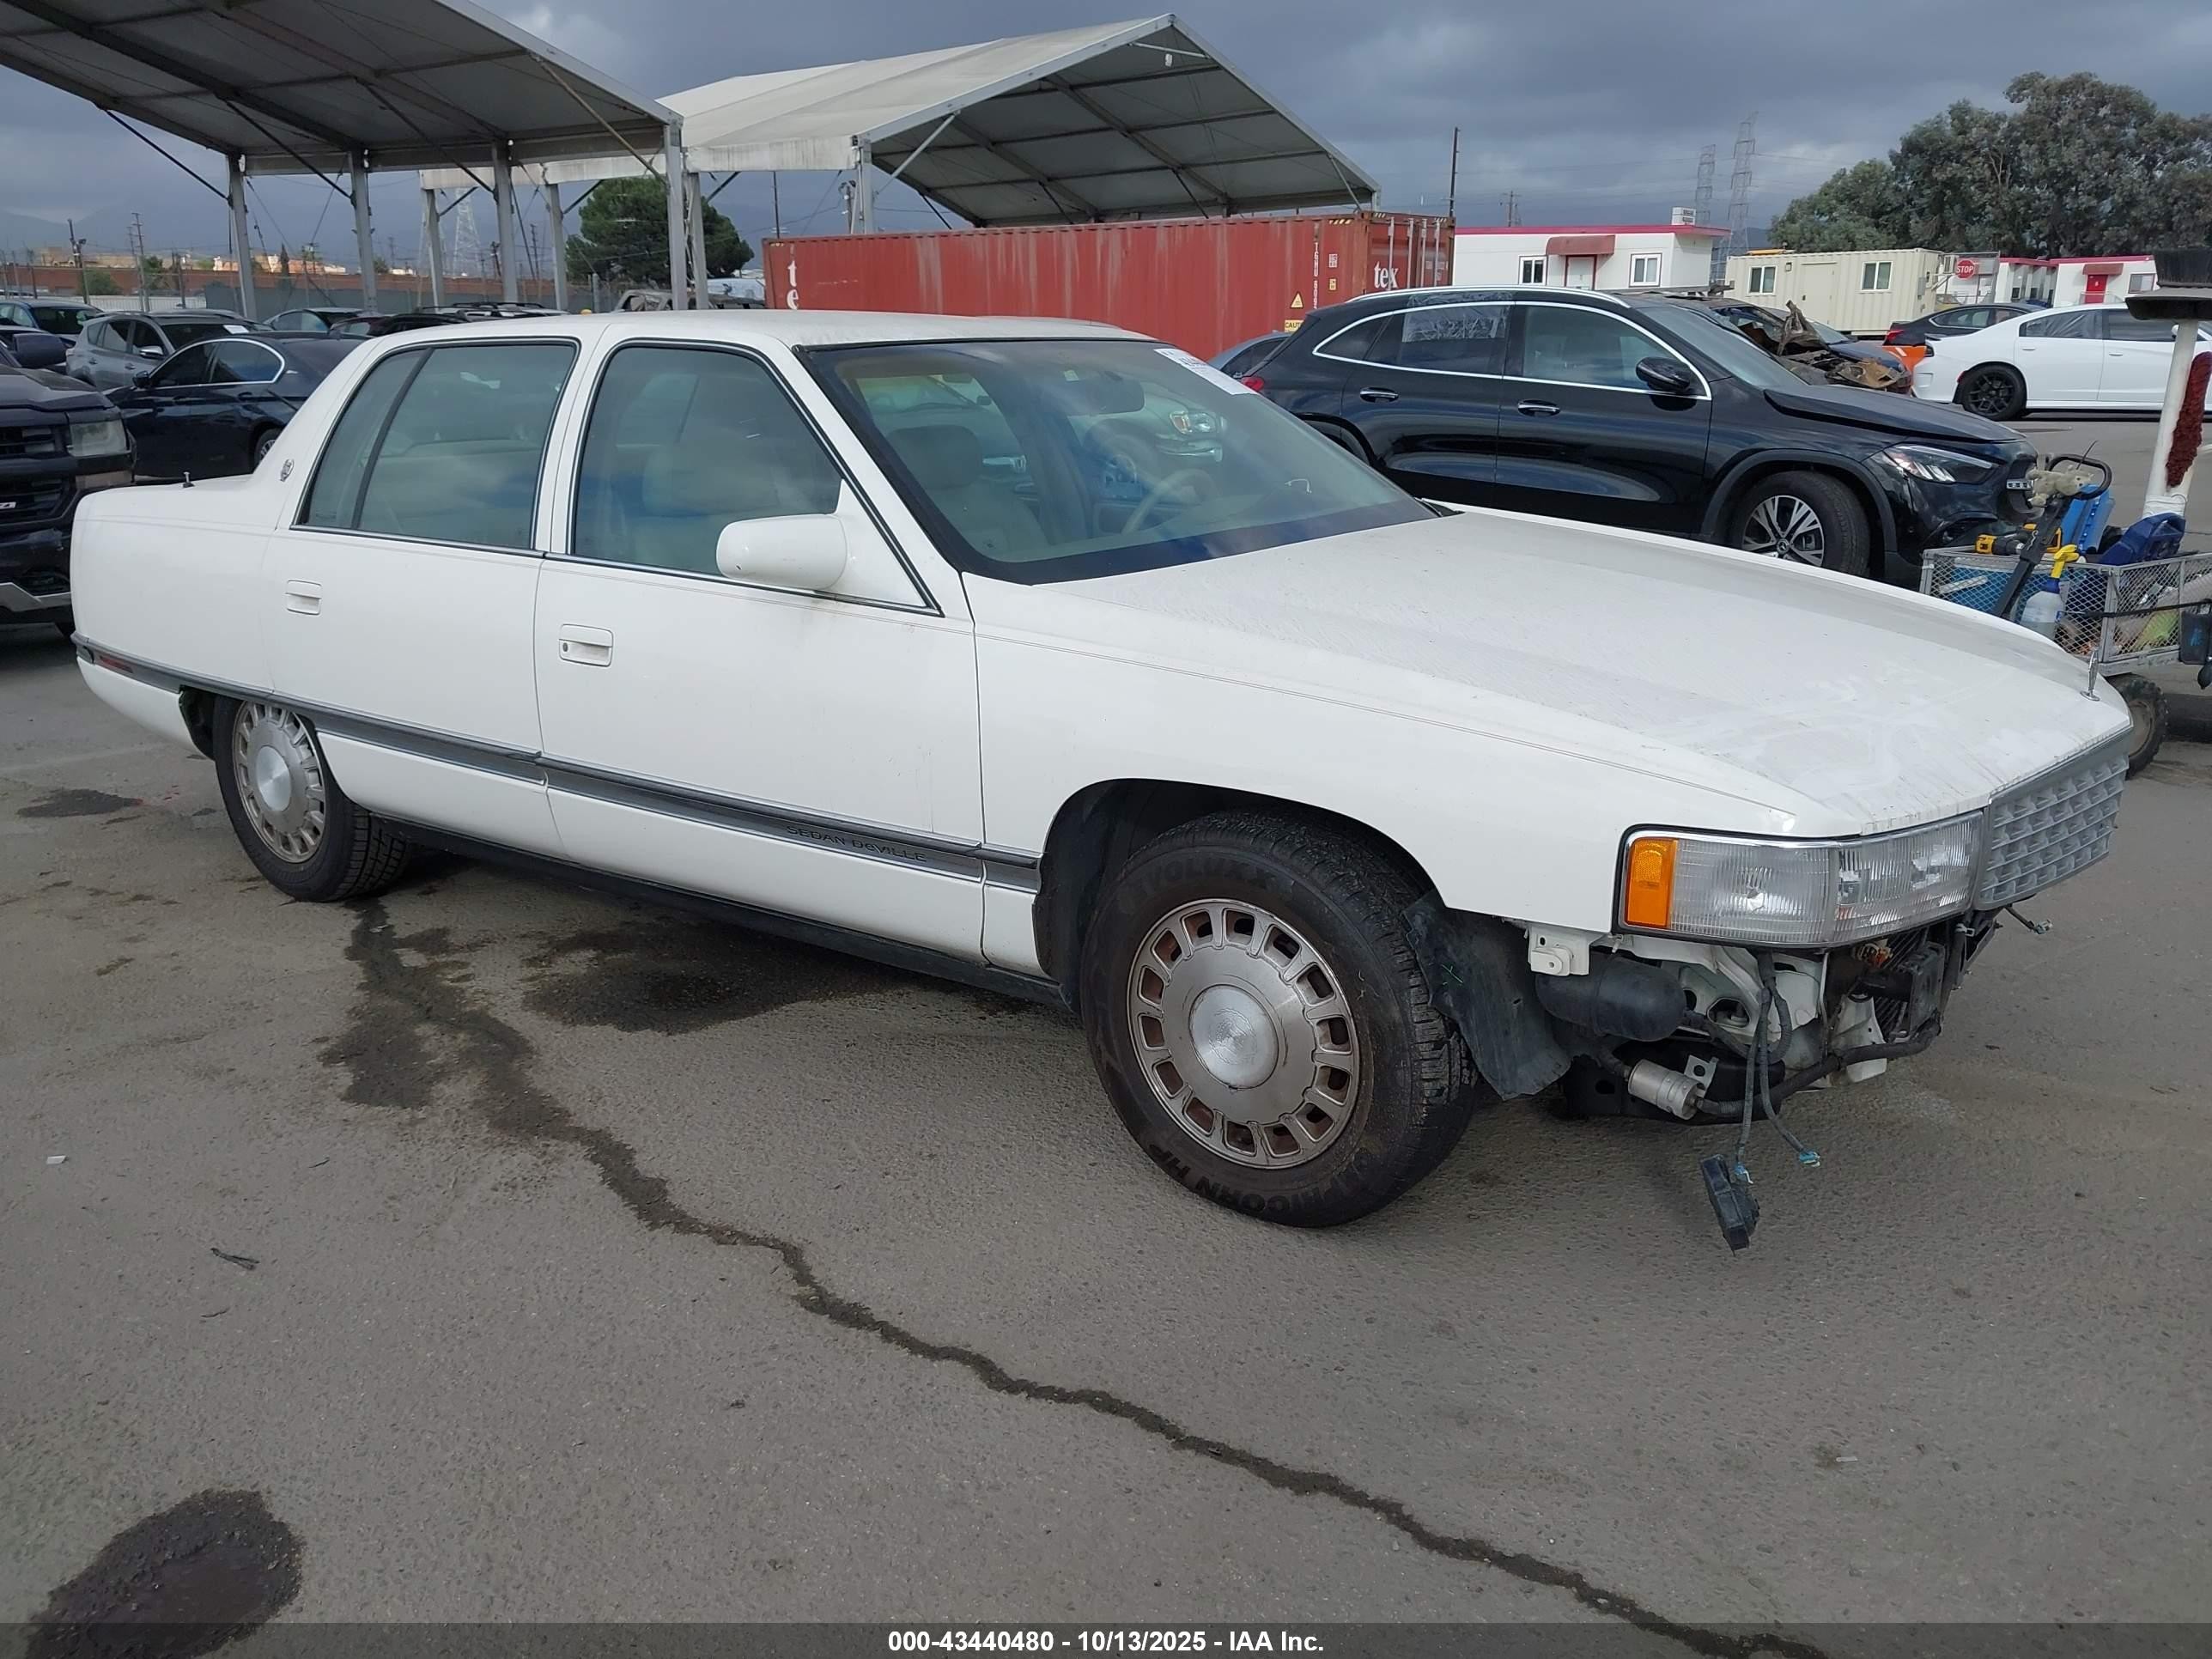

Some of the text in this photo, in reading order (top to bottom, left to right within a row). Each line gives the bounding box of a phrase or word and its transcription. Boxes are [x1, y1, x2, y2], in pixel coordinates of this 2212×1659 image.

[1957, 265, 1974, 274] STOP
[787, 825, 927, 862] SEDAN DeVILLE
